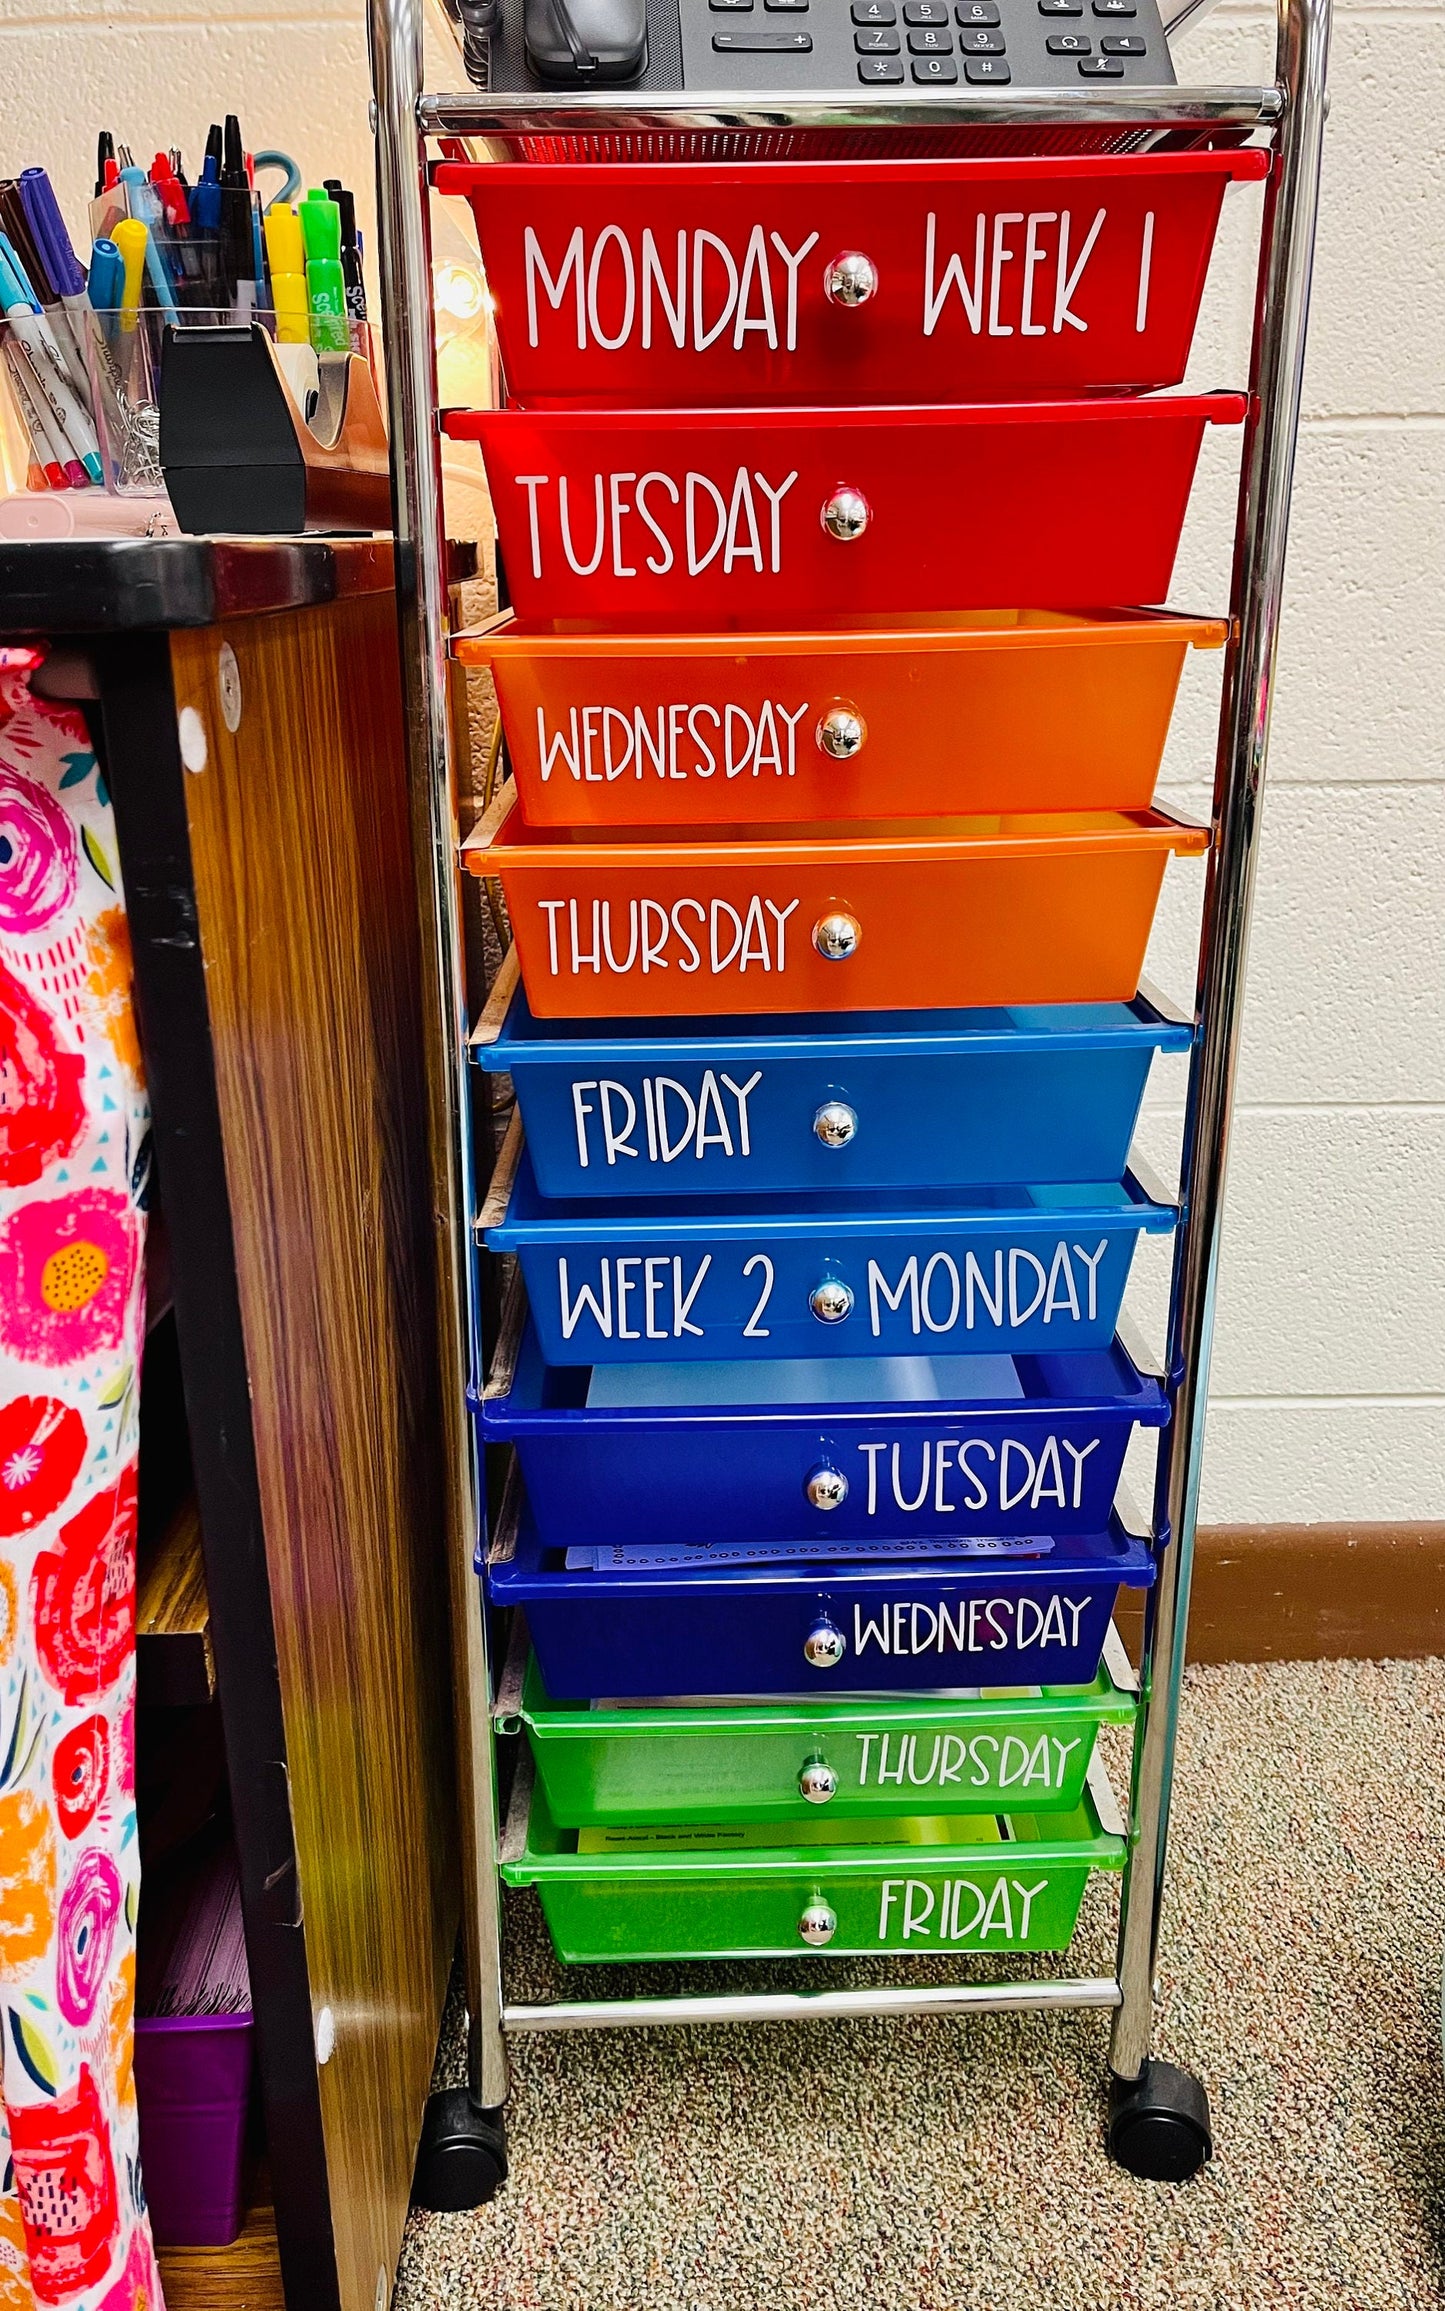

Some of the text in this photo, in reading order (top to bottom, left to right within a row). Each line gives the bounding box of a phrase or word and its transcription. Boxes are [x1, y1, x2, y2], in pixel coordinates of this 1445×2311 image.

[868, 4, 880, 15] 4
[872, 32, 883, 43] 7
[920, 4, 932, 15] 5
[924, 32, 936, 43] 8
[971, 5, 984, 16] 6
[976, 33, 988, 44] 9
[928, 61, 940, 73] 0
[524, 208, 1155, 352] MONDAY WEEK 1
[312, 292, 348, 346] Scented
[515, 466, 798, 579] TUESDAY
[537, 699, 809, 782] WEDNESDAY
[538, 895, 800, 975] THURSDAY
[572, 1069, 763, 1167] FRIDAY
[558, 1239, 1108, 1339] WEEK 2 MONDAY
[857, 1437, 1100, 1516] TUESDAY
[854, 1594, 1092, 1656] WEDNESDAY
[855, 1733, 1082, 1790] THURSDAY
[878, 1877, 1049, 1940] FRIDAY
